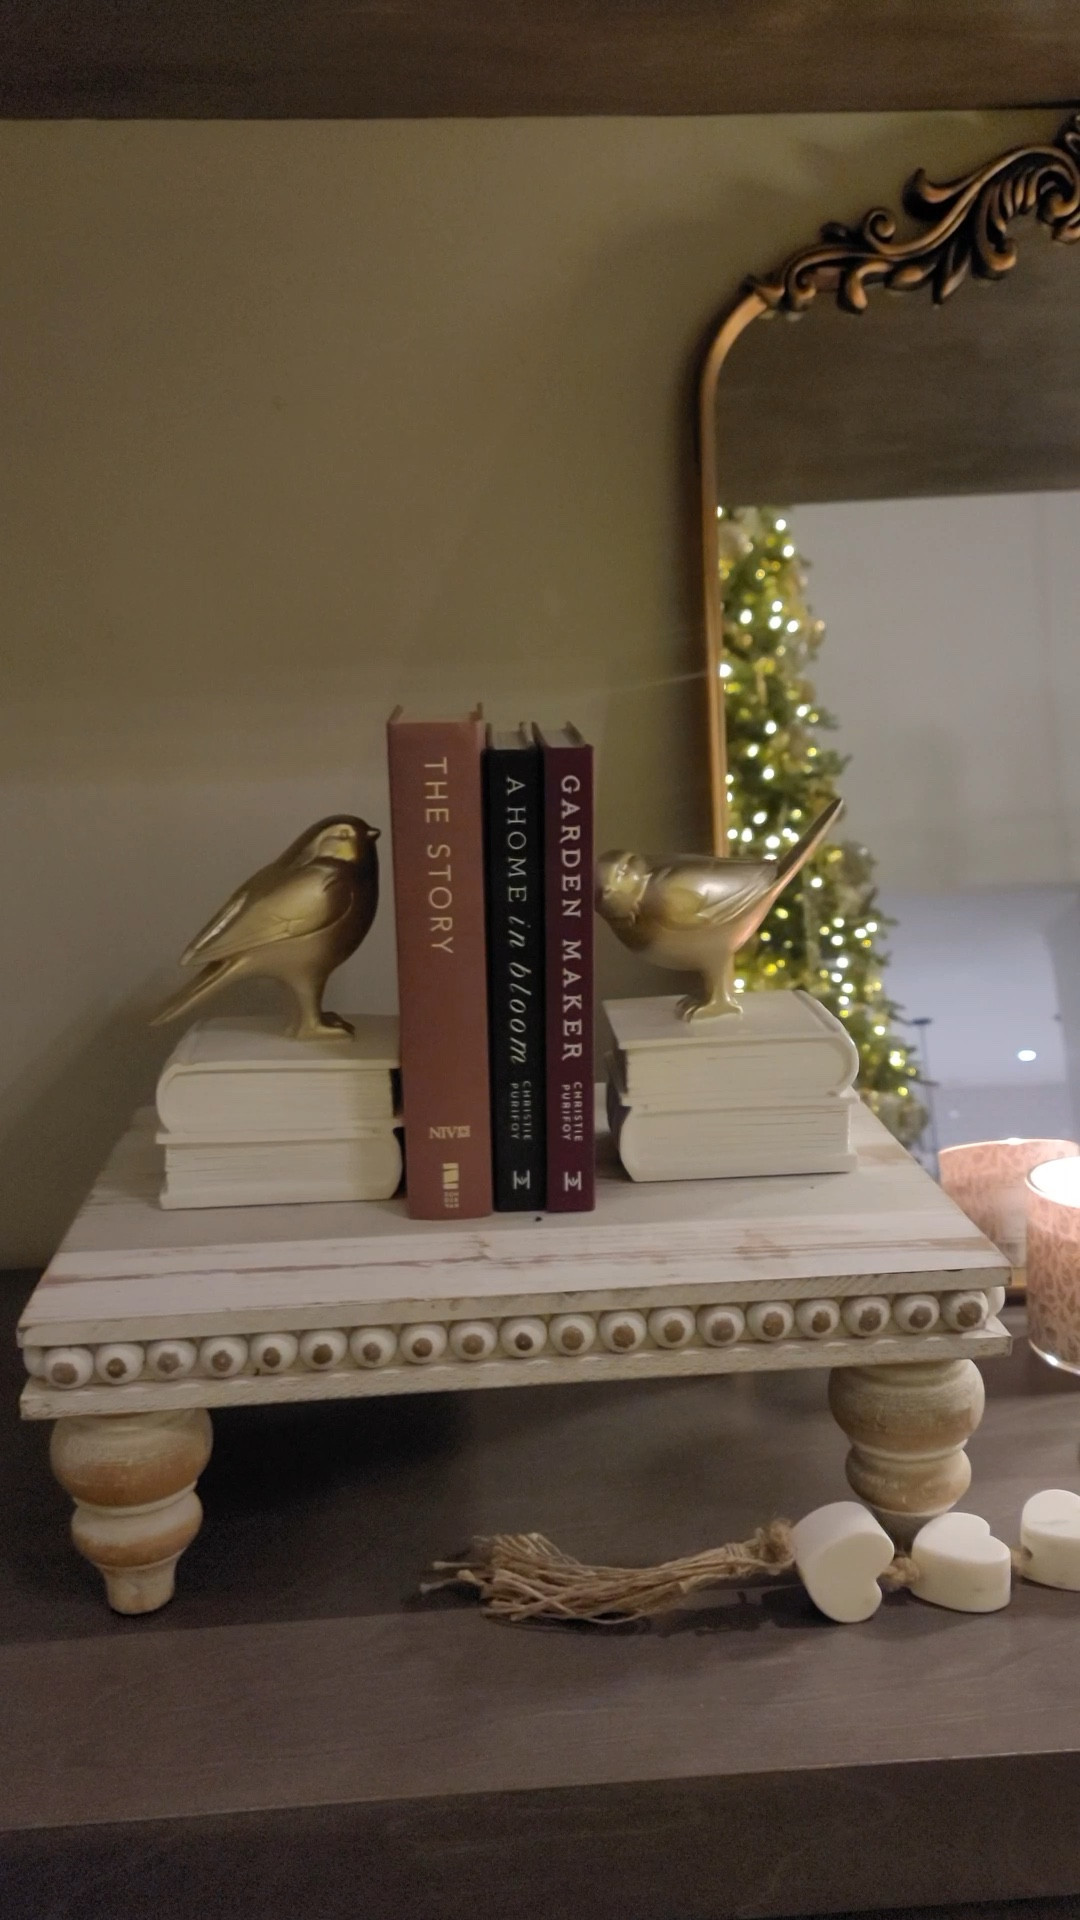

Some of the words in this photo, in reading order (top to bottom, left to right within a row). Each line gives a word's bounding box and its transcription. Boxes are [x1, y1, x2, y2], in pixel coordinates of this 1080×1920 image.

[424, 757, 449, 823] THE
[507, 777, 526, 795] A
[507, 806, 527, 902] HOME
[559, 775, 581, 918] GARDEN
[427, 844, 454, 954] STORY
[508, 916, 531, 948] in
[510, 962, 532, 1063] bloom
[561, 939, 582, 1061] MAKER
[510, 1082, 520, 1139] PURIFOY
[522, 1080, 531, 1140] CHRISTIE
[562, 1084, 572, 1141] PURIFOY
[574, 1081, 583, 1142] CHRISTIE
